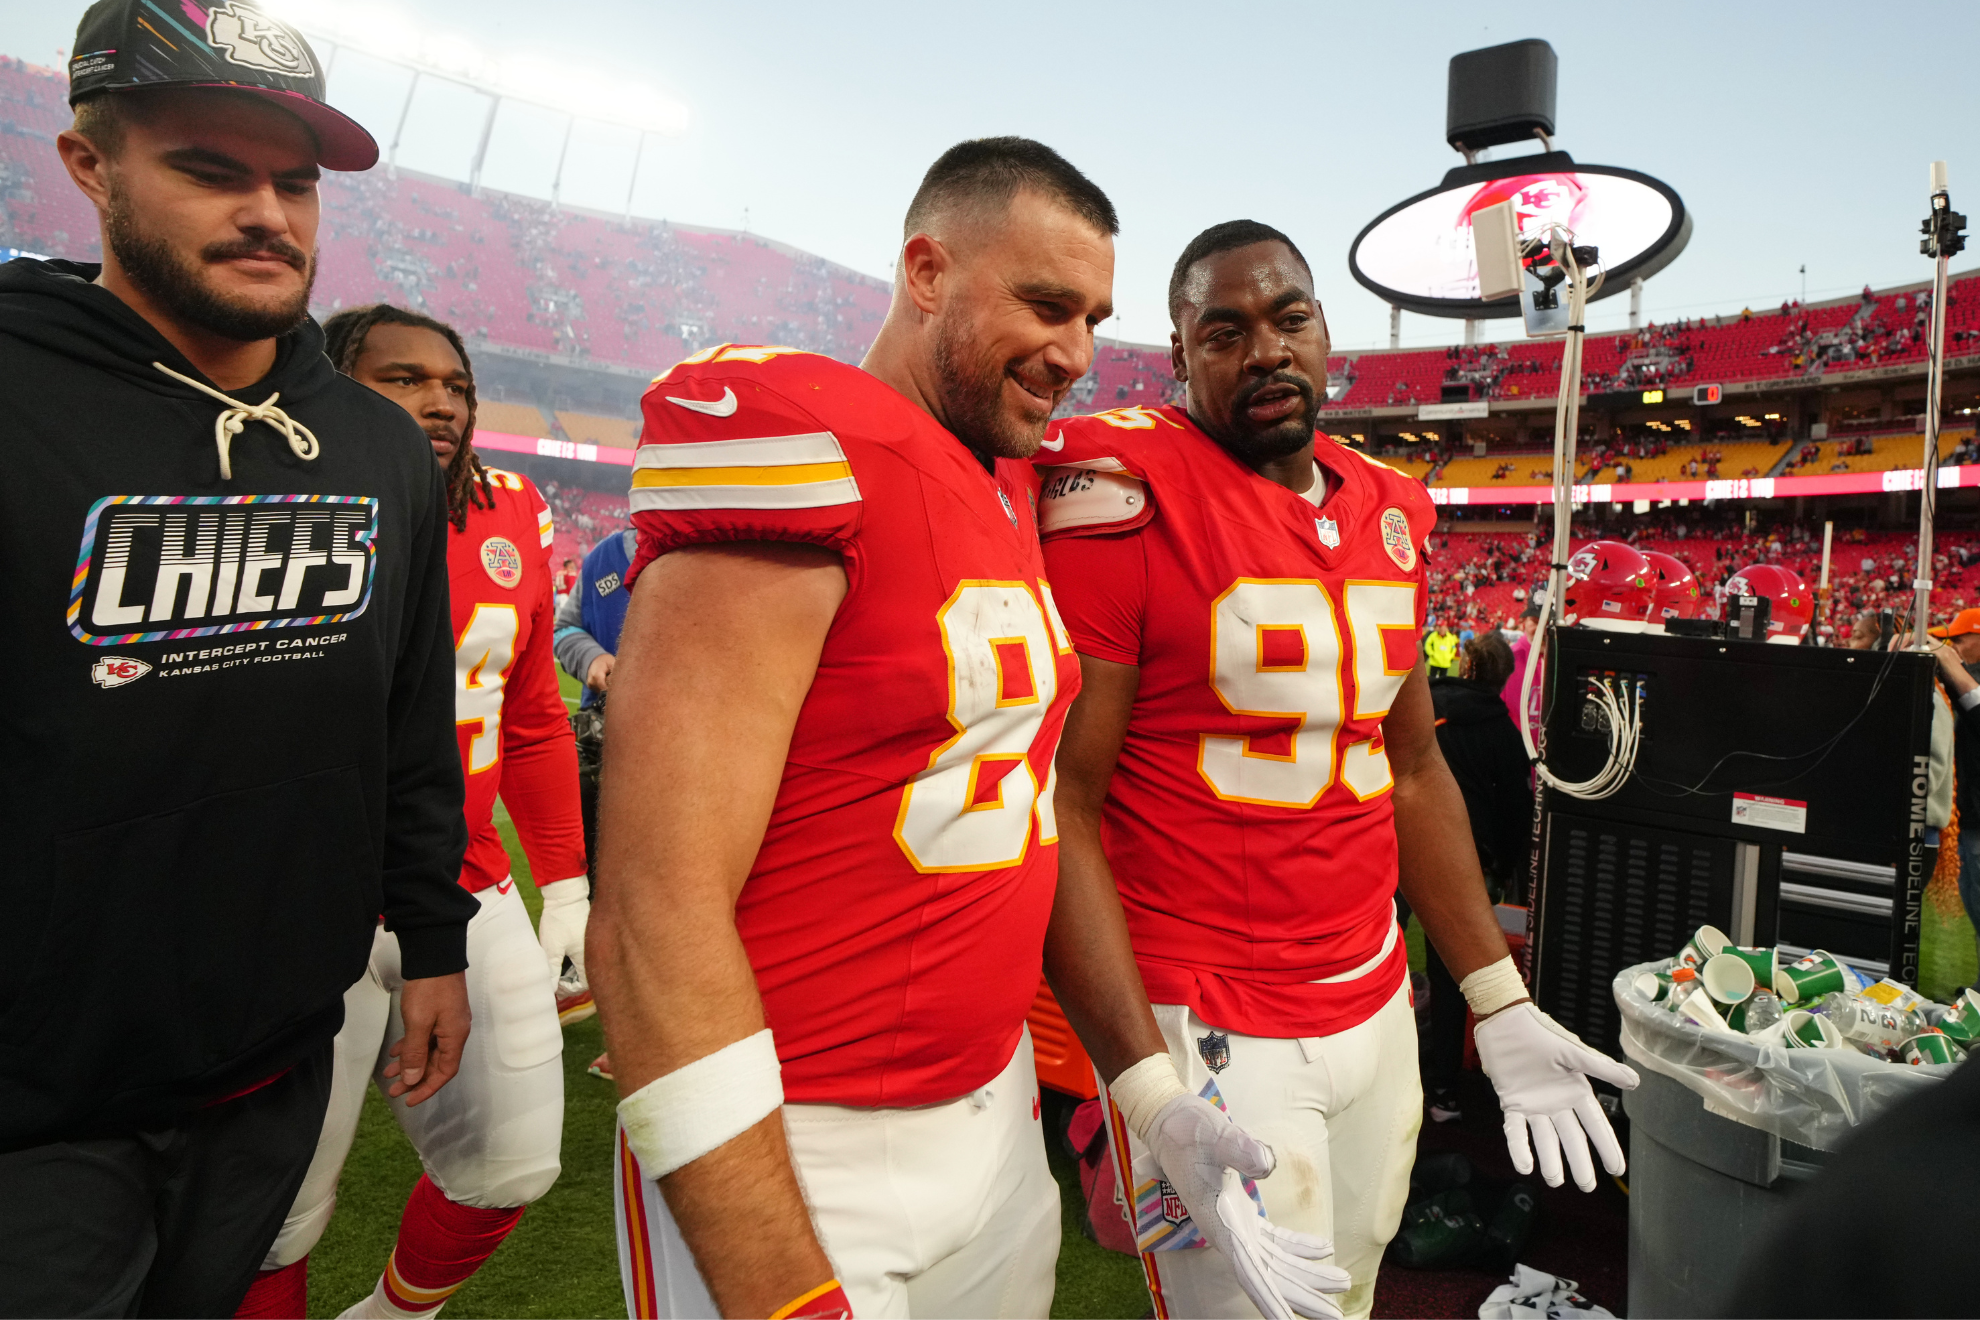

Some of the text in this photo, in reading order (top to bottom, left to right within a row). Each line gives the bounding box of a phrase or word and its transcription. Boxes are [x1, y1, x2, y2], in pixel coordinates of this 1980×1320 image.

[91, 510, 367, 627] CHIEFS
[598, 575, 619, 594] SDS
[158, 650, 326, 678] KANSAS CITY FOOTBALL
[161, 633, 348, 664] INTERCEPT CANCER
[1197, 577, 1419, 810] 95
[1909, 755, 1929, 839] HOME
[1905, 842, 1923, 933] SIDELINE
